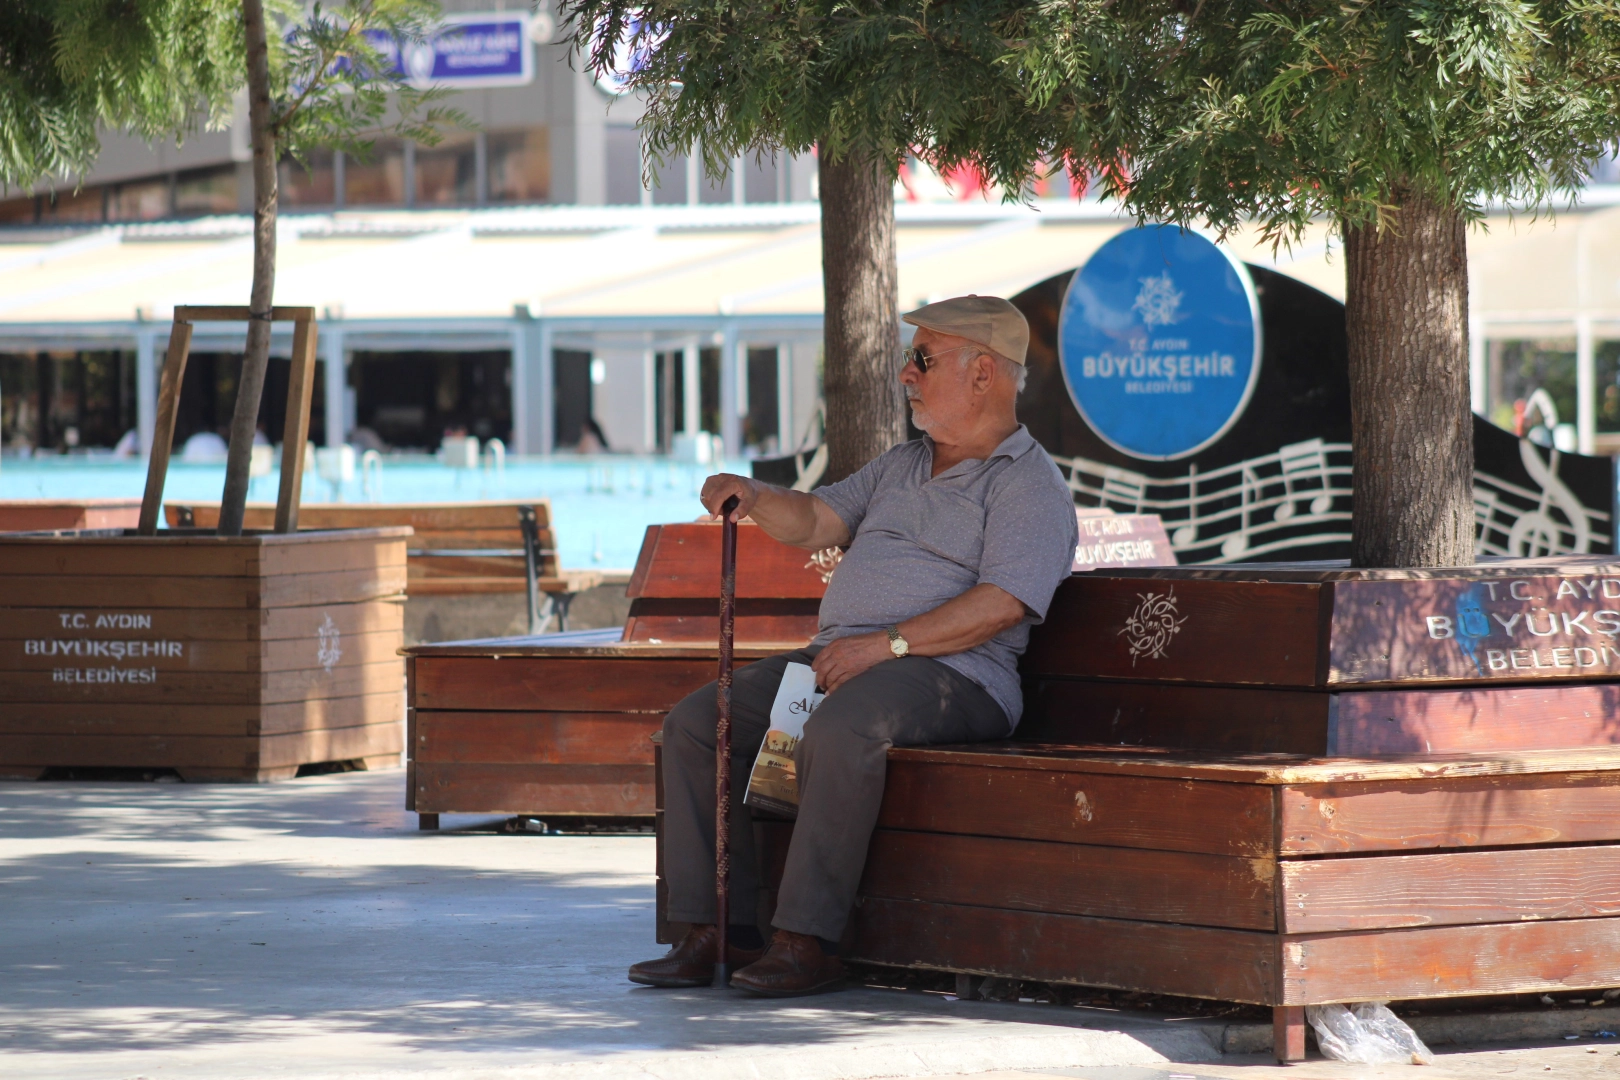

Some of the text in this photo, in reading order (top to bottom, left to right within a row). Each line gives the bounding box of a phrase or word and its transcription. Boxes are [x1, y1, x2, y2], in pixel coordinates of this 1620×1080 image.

[1152, 338, 1188, 351] AYDIN
[1083, 352, 1234, 380] BÜYÜKŞEHİR
[1482, 579, 1544, 601] T.C.
[59, 613, 151, 629] T.C. AYDIN
[24, 637, 183, 661] BÜYÜKŞEHİR
[53, 666, 157, 684] BELEDİYESİ
